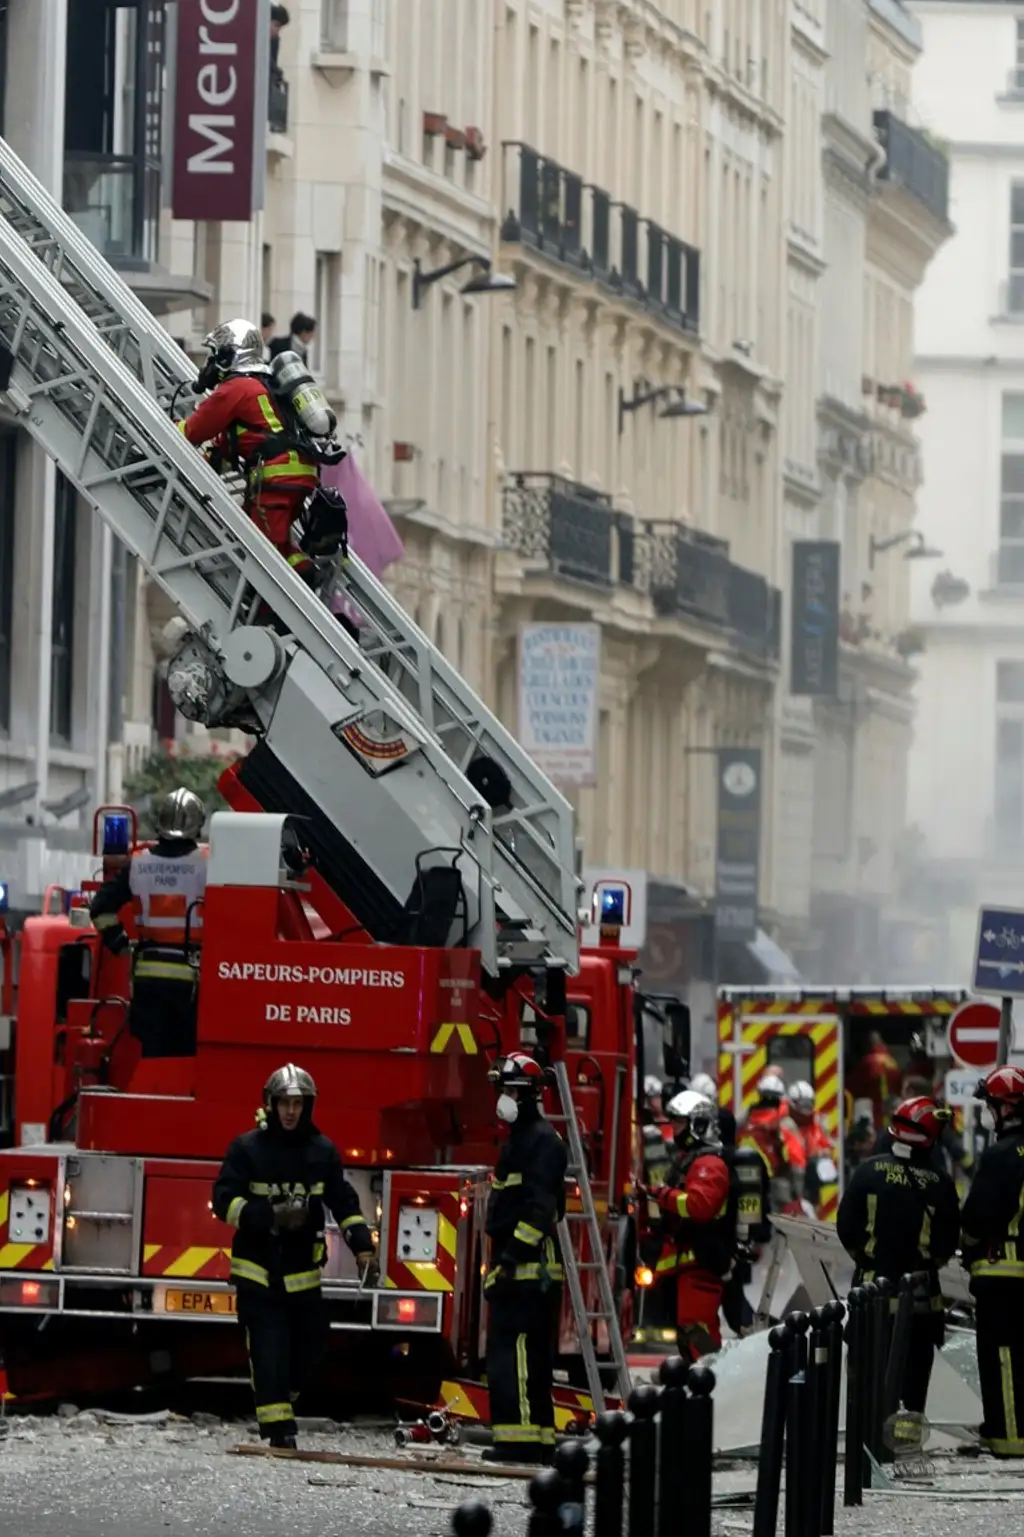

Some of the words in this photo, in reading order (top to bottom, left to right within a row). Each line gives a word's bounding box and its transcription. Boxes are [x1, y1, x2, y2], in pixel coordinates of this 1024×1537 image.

[218, 961, 405, 988] SAPEURS-POMPIERS
[265, 1004, 292, 1022] DE
[297, 1005, 352, 1026] PARIS
[182, 1292, 213, 1312] EPA
